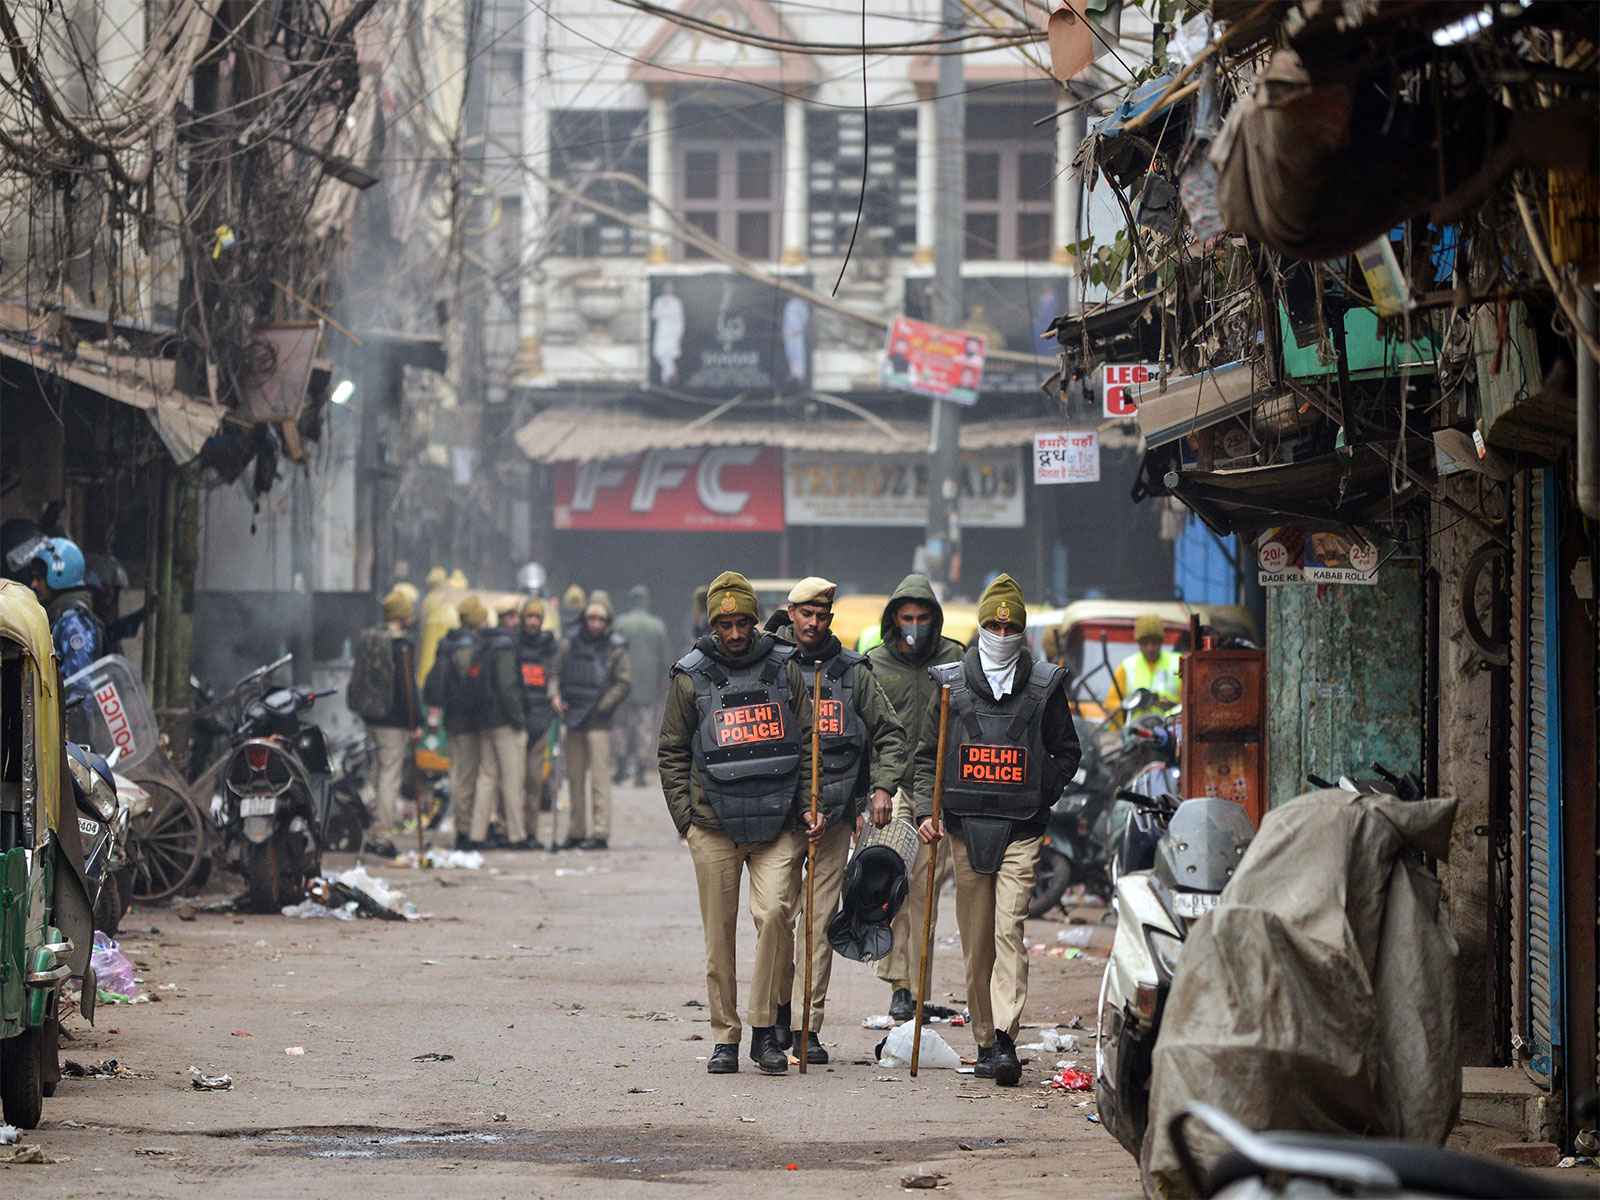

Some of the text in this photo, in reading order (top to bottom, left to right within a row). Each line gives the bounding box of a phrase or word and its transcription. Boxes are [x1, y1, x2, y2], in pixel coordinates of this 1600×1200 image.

[1106, 366, 1148, 384] LEG
[570, 447, 764, 513] FFC
[1262, 573, 1284, 582] BADE
[1313, 570, 1343, 580] KABAB
[1344, 572, 1368, 581] ROLL
[97, 685, 135, 759] POLICE
[723, 706, 772, 726] DELHI
[720, 721, 780, 743] POLICE
[969, 748, 1018, 764] DELHI
[963, 764, 1022, 781] POLICE
